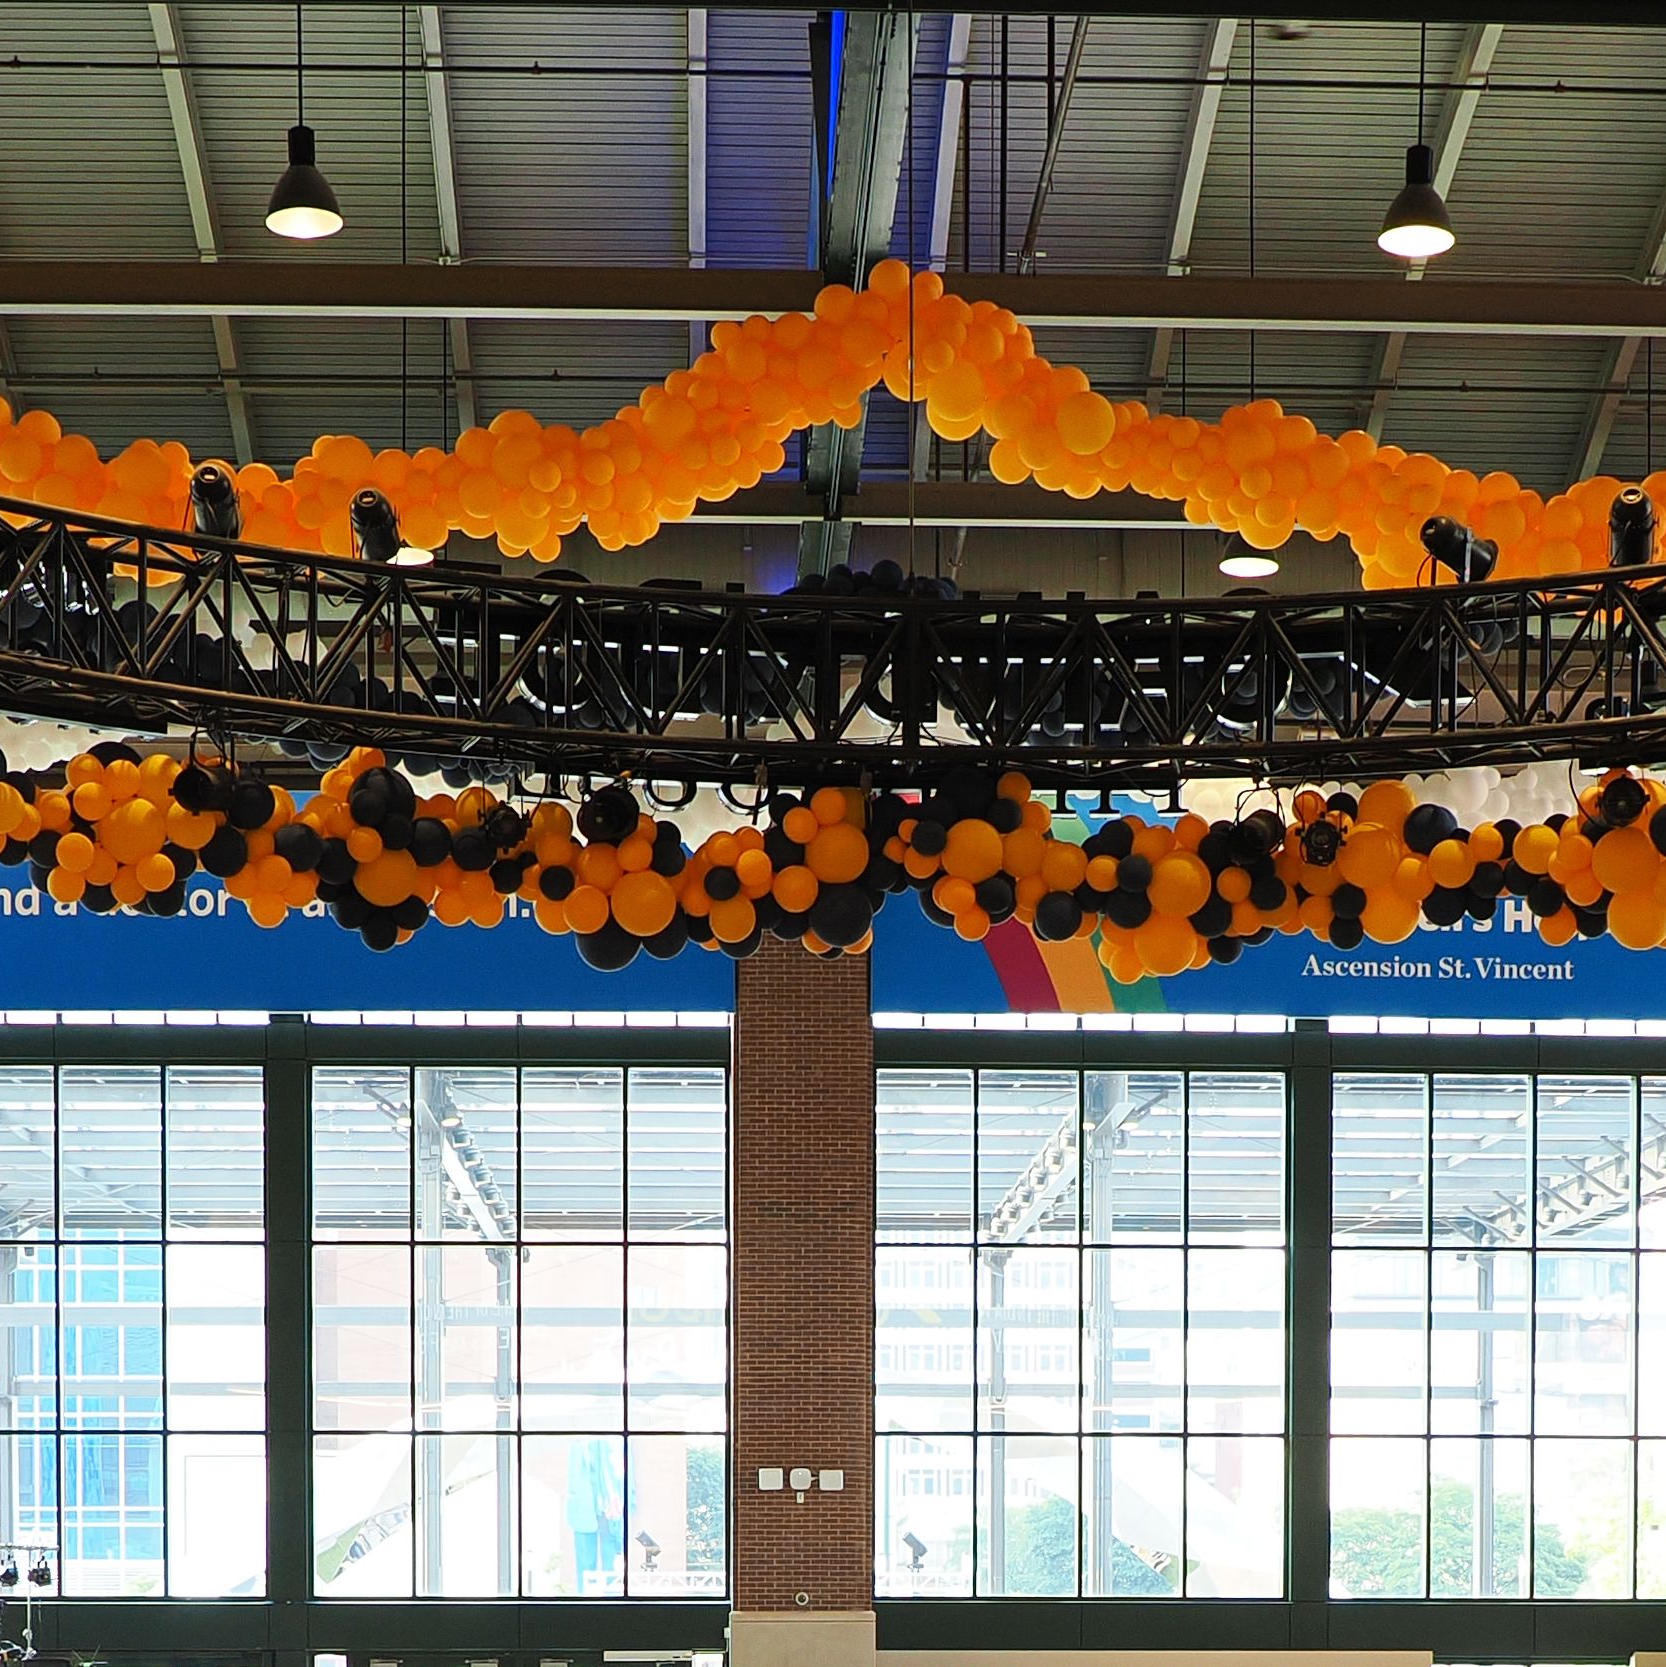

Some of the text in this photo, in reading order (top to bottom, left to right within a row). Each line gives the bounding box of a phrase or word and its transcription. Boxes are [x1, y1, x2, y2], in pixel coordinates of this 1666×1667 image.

[1301, 953, 1575, 981] Ascension St. Vincent
